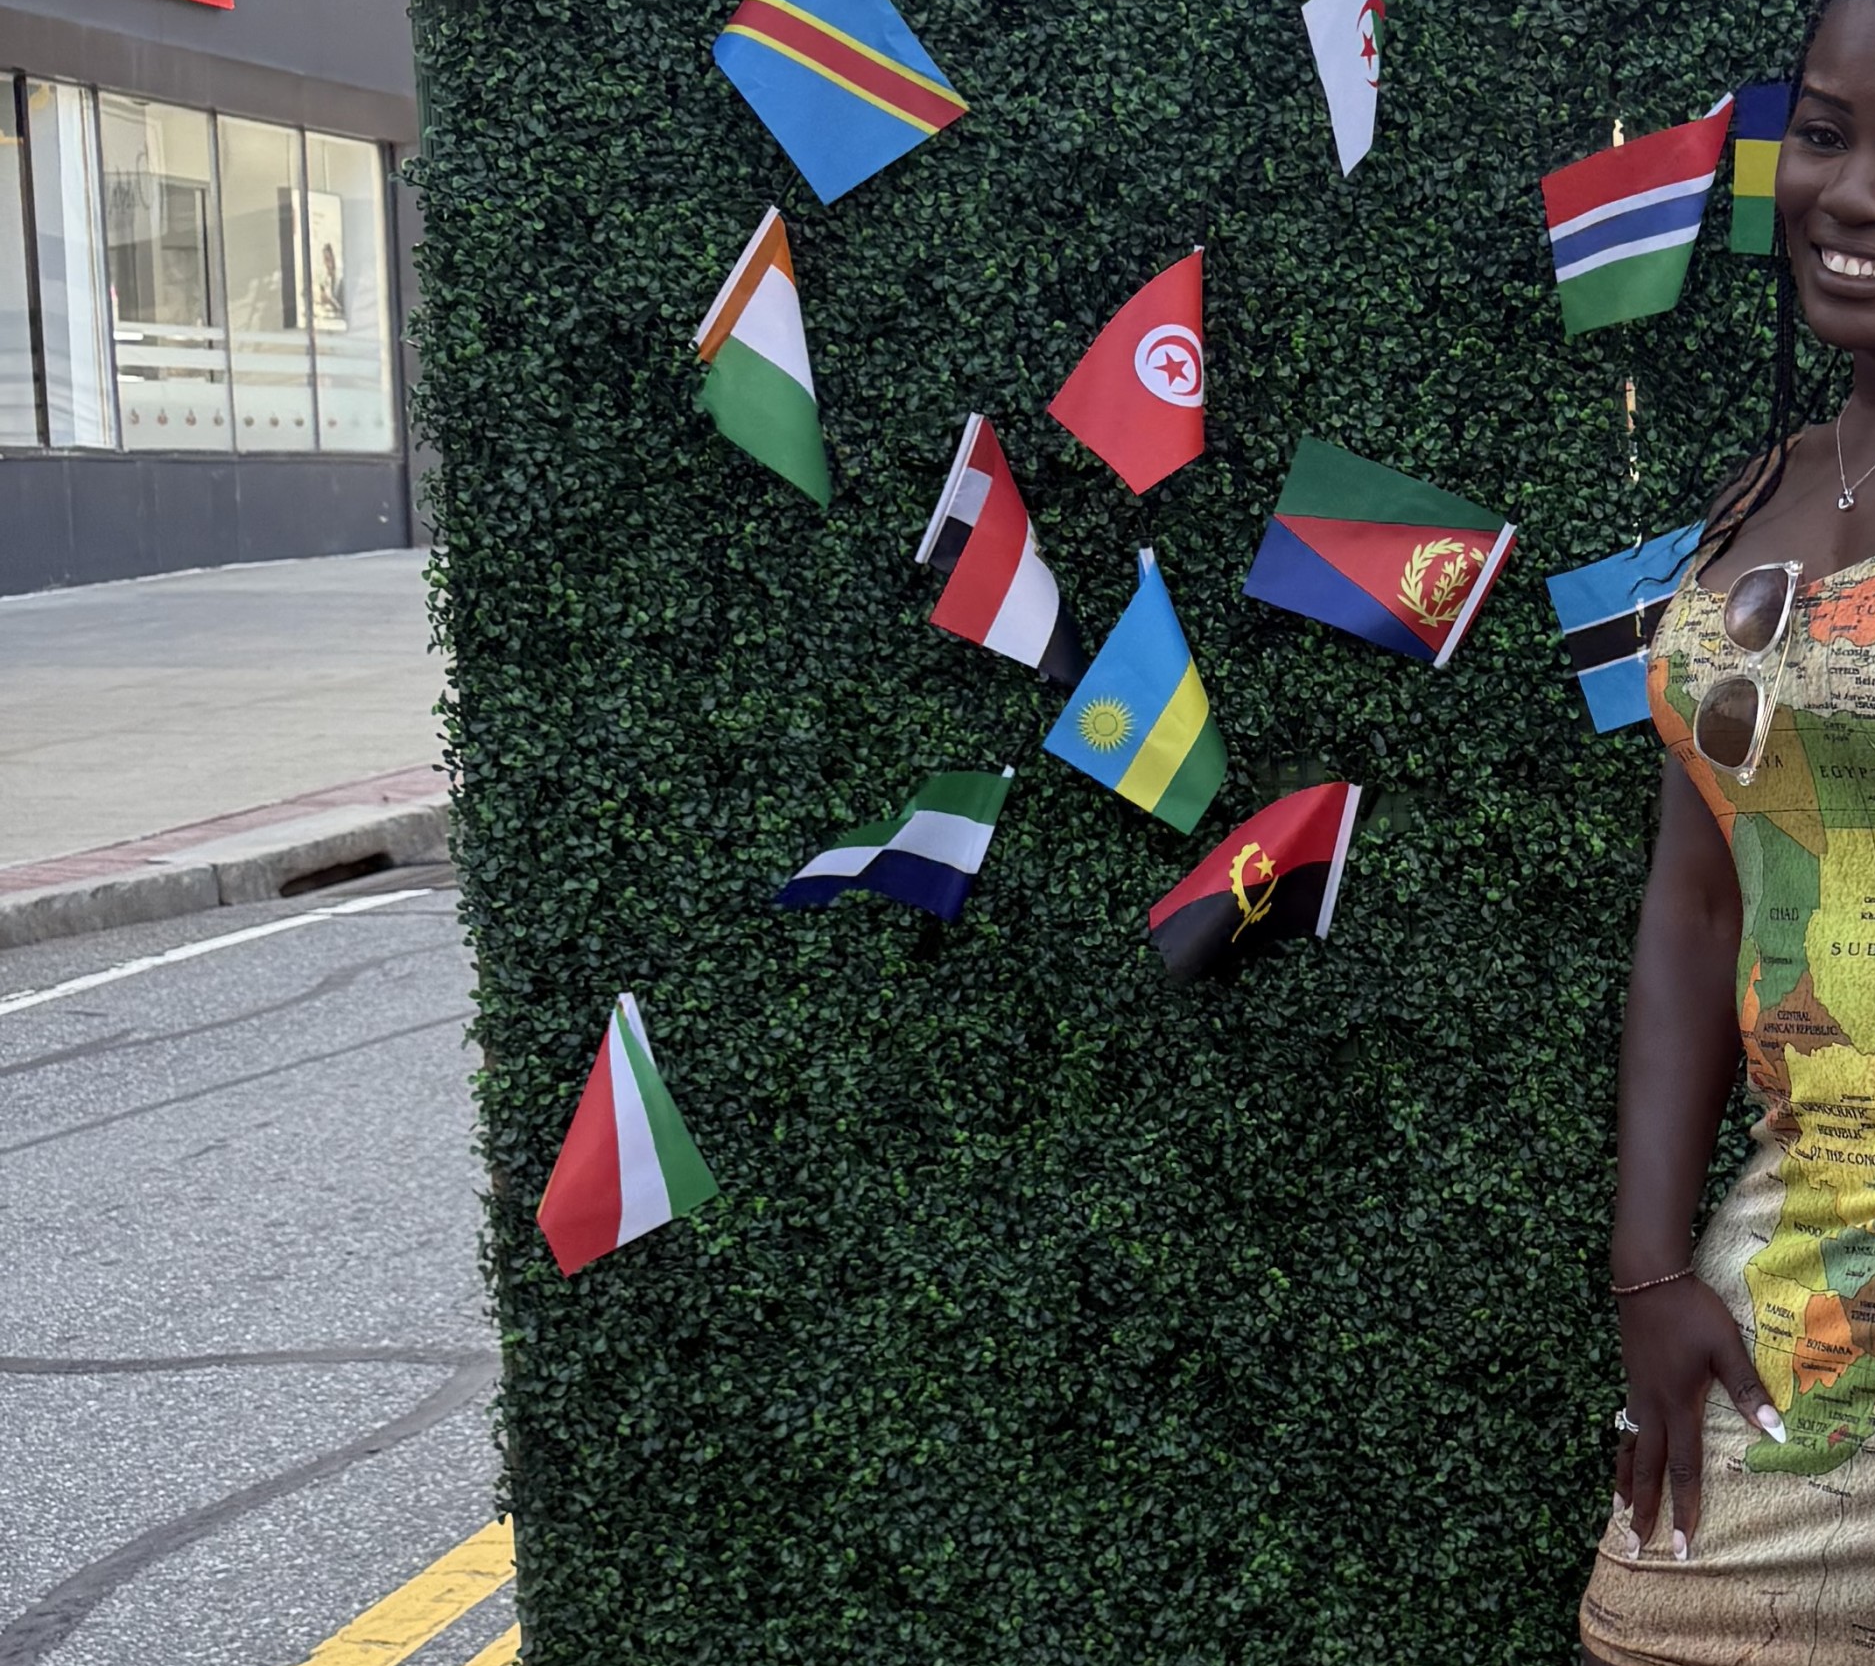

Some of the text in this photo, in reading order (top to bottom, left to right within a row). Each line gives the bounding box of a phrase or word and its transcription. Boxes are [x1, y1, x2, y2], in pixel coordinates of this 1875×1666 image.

[1769, 906, 1800, 922] CHAD
[1776, 1010, 1811, 1022] CENTRAL
[1806, 1338, 1853, 1355] BOTSWANA
